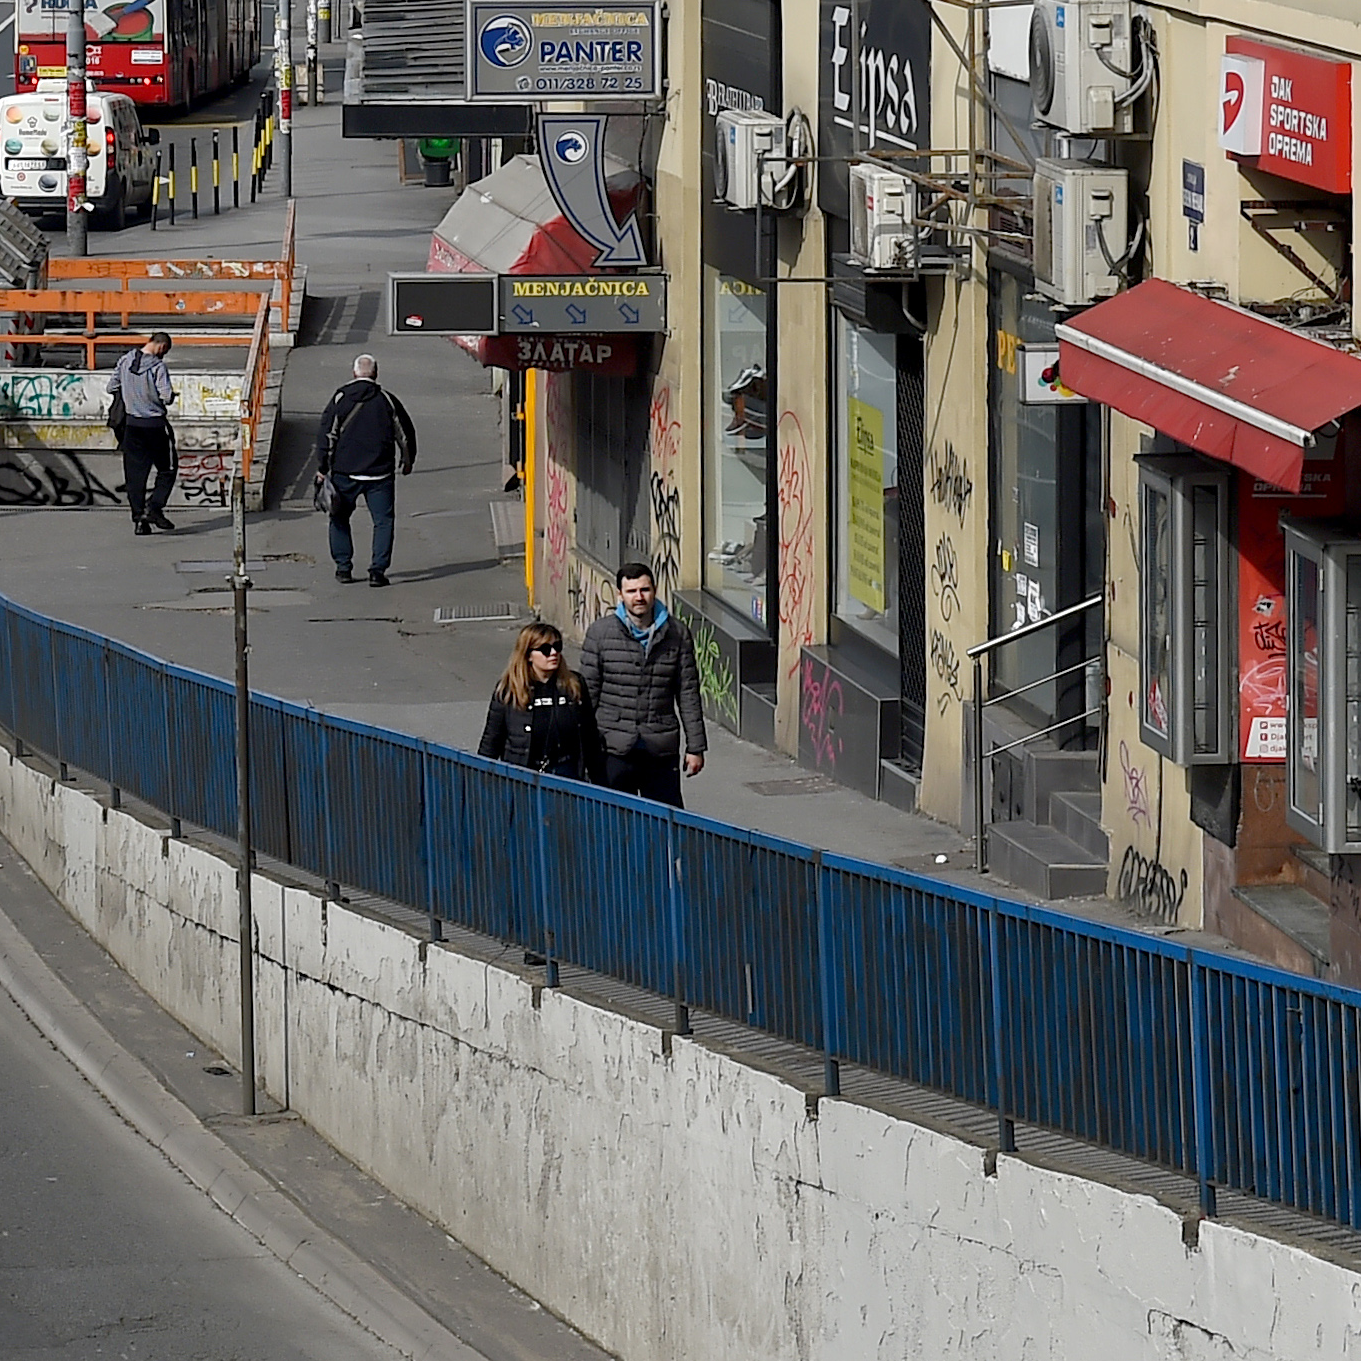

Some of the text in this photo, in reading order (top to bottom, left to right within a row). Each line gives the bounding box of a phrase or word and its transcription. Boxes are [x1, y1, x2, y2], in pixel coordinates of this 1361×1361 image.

[531, 9, 650, 27] MENJAČNICA
[540, 40, 644, 64] PANTER
[536, 77, 643, 90] 011/328 72 25
[831, 5, 918, 149] Eipsa
[1269, 103, 1328, 142] SPORTSKA
[1268, 132, 1313, 167] OPREMA
[513, 277, 649, 297] MENJAČNICA
[517, 342, 613, 364] ЗЛАТАР
